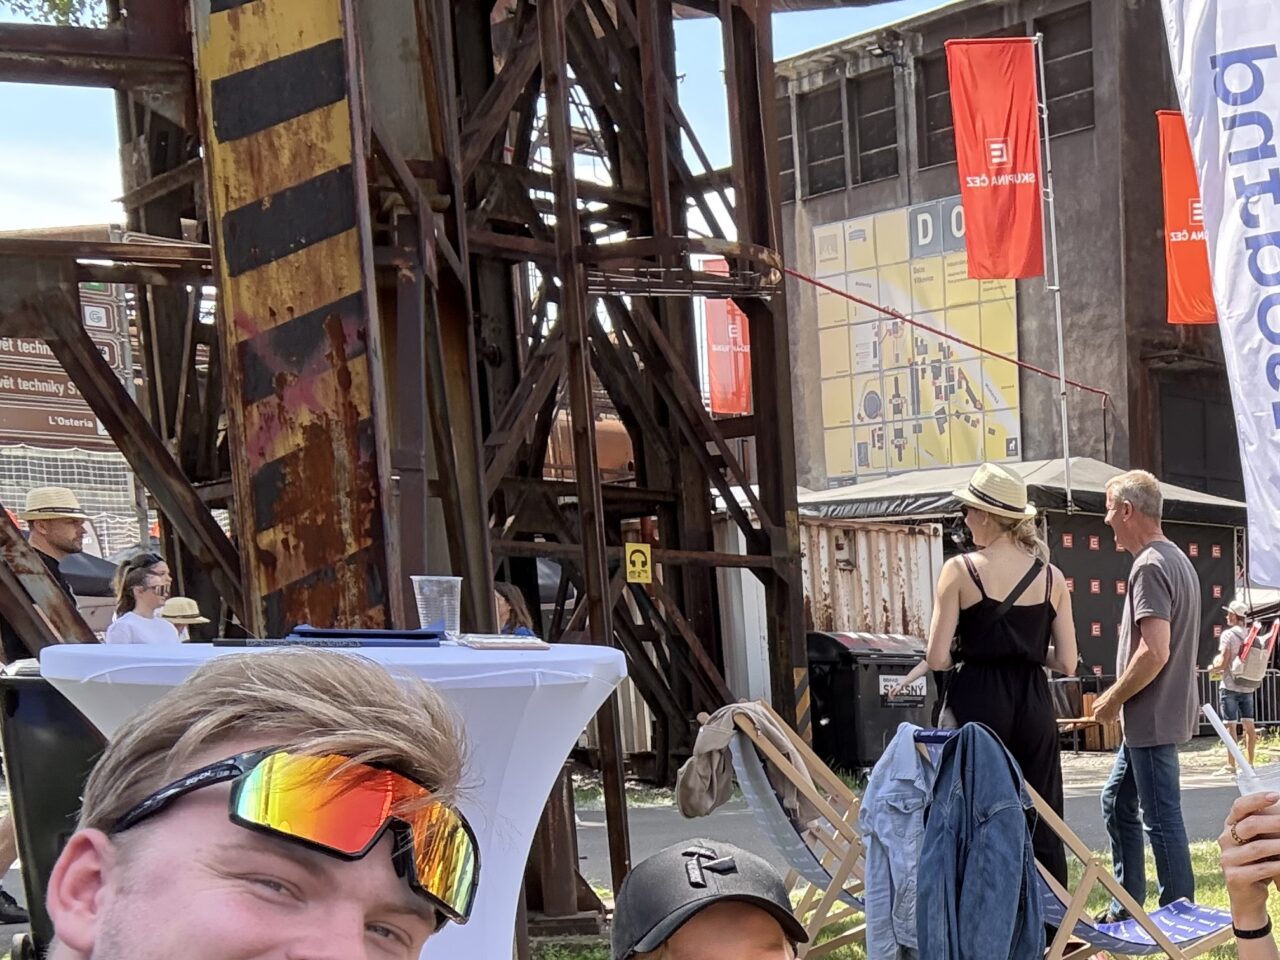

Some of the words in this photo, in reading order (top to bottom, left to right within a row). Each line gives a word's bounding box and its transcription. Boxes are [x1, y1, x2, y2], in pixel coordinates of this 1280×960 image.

[17, 339, 52, 355] techn
[18, 378, 65, 396] techniky
[49, 415, 94, 428] L'Osteria
[883, 682, 924, 696] SSNÝ
